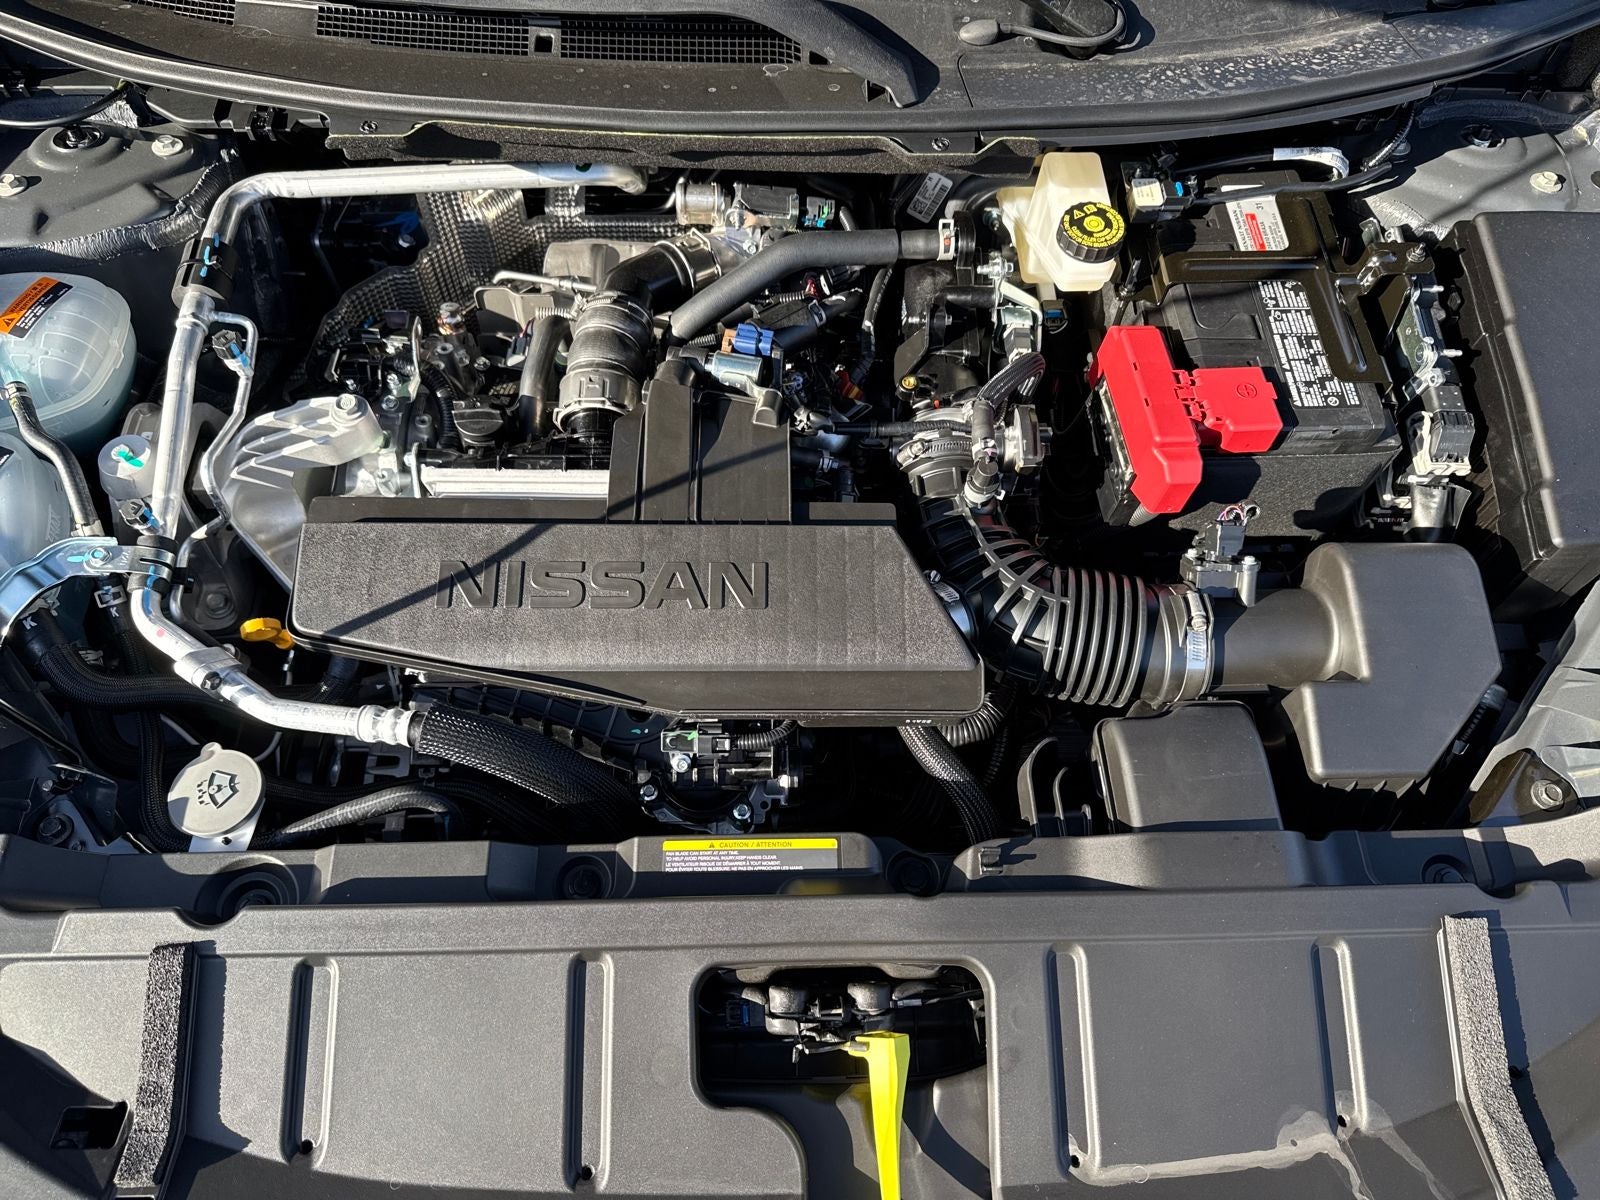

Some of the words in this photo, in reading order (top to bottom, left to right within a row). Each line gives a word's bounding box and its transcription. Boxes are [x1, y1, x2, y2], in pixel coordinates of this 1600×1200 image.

[434, 561, 768, 609] NISSAN
[110, 607, 119, 618] K
[22, 616, 38, 630] K
